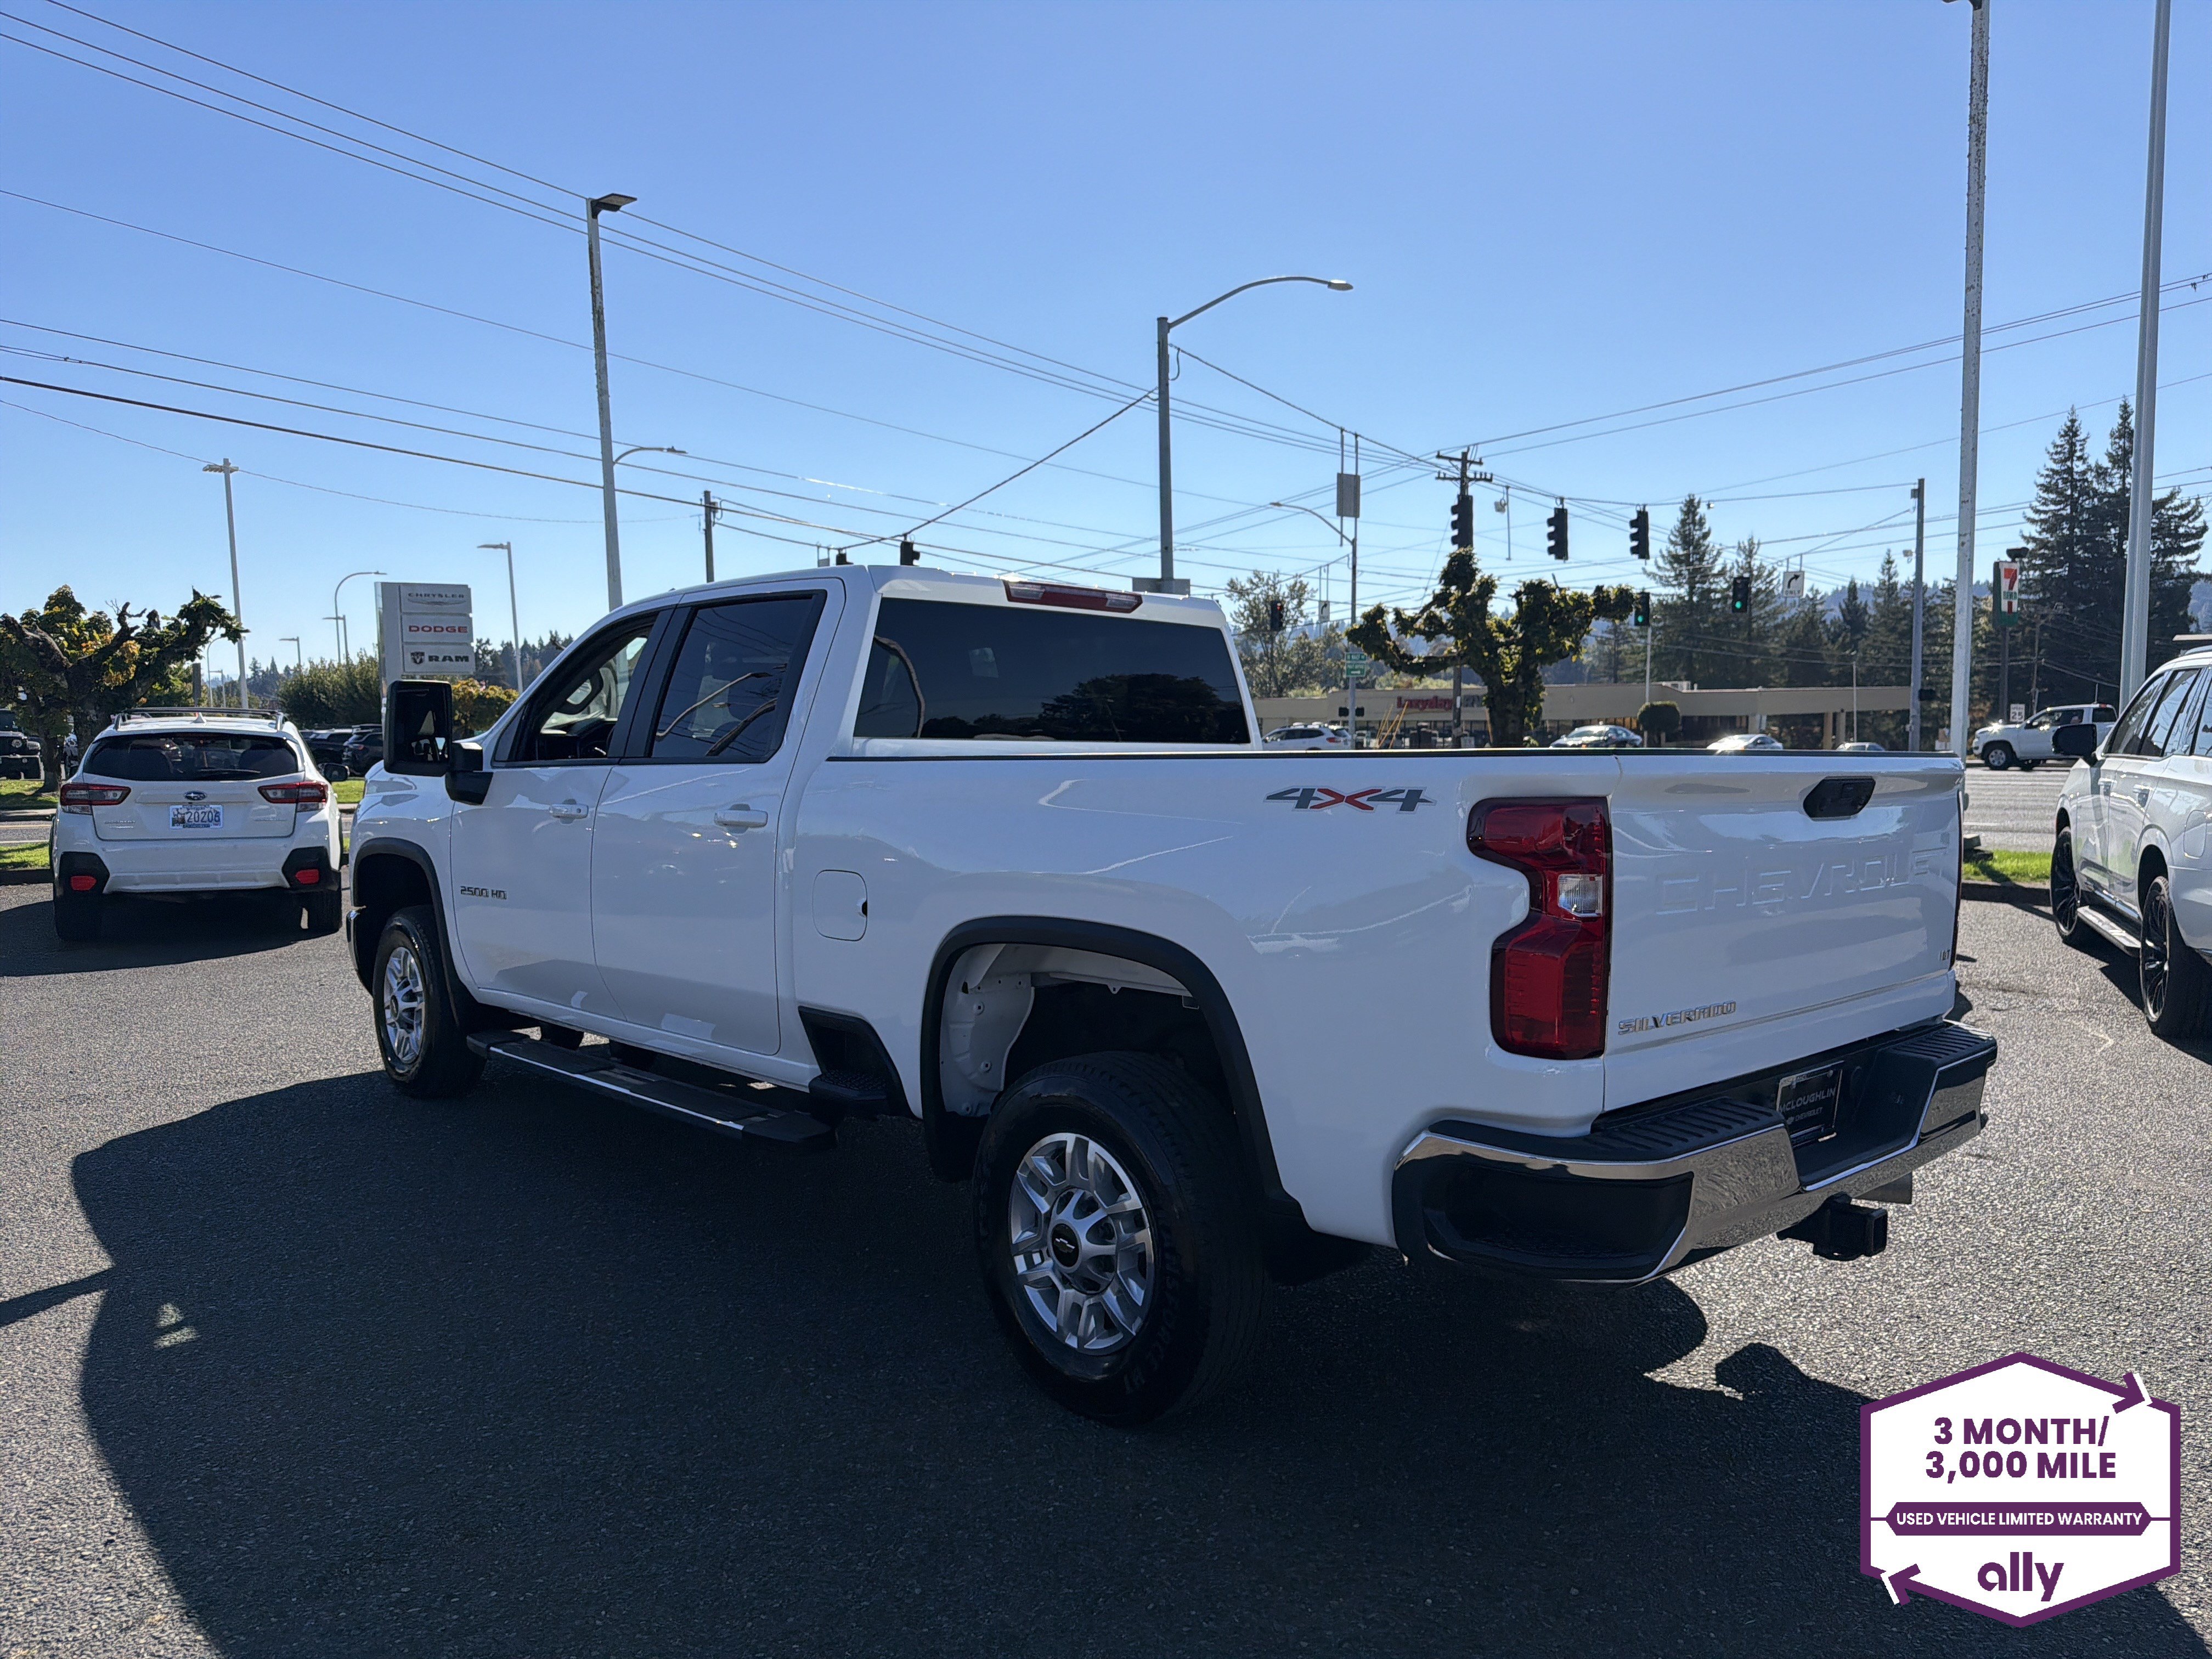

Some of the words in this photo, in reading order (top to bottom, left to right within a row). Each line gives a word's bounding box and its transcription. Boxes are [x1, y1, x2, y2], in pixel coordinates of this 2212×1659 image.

[408, 625, 468, 633] DODGE
[460, 885, 489, 898] 2500
[491, 889, 507, 900] HD
[1618, 1000, 1736, 1035] SILVERADO
